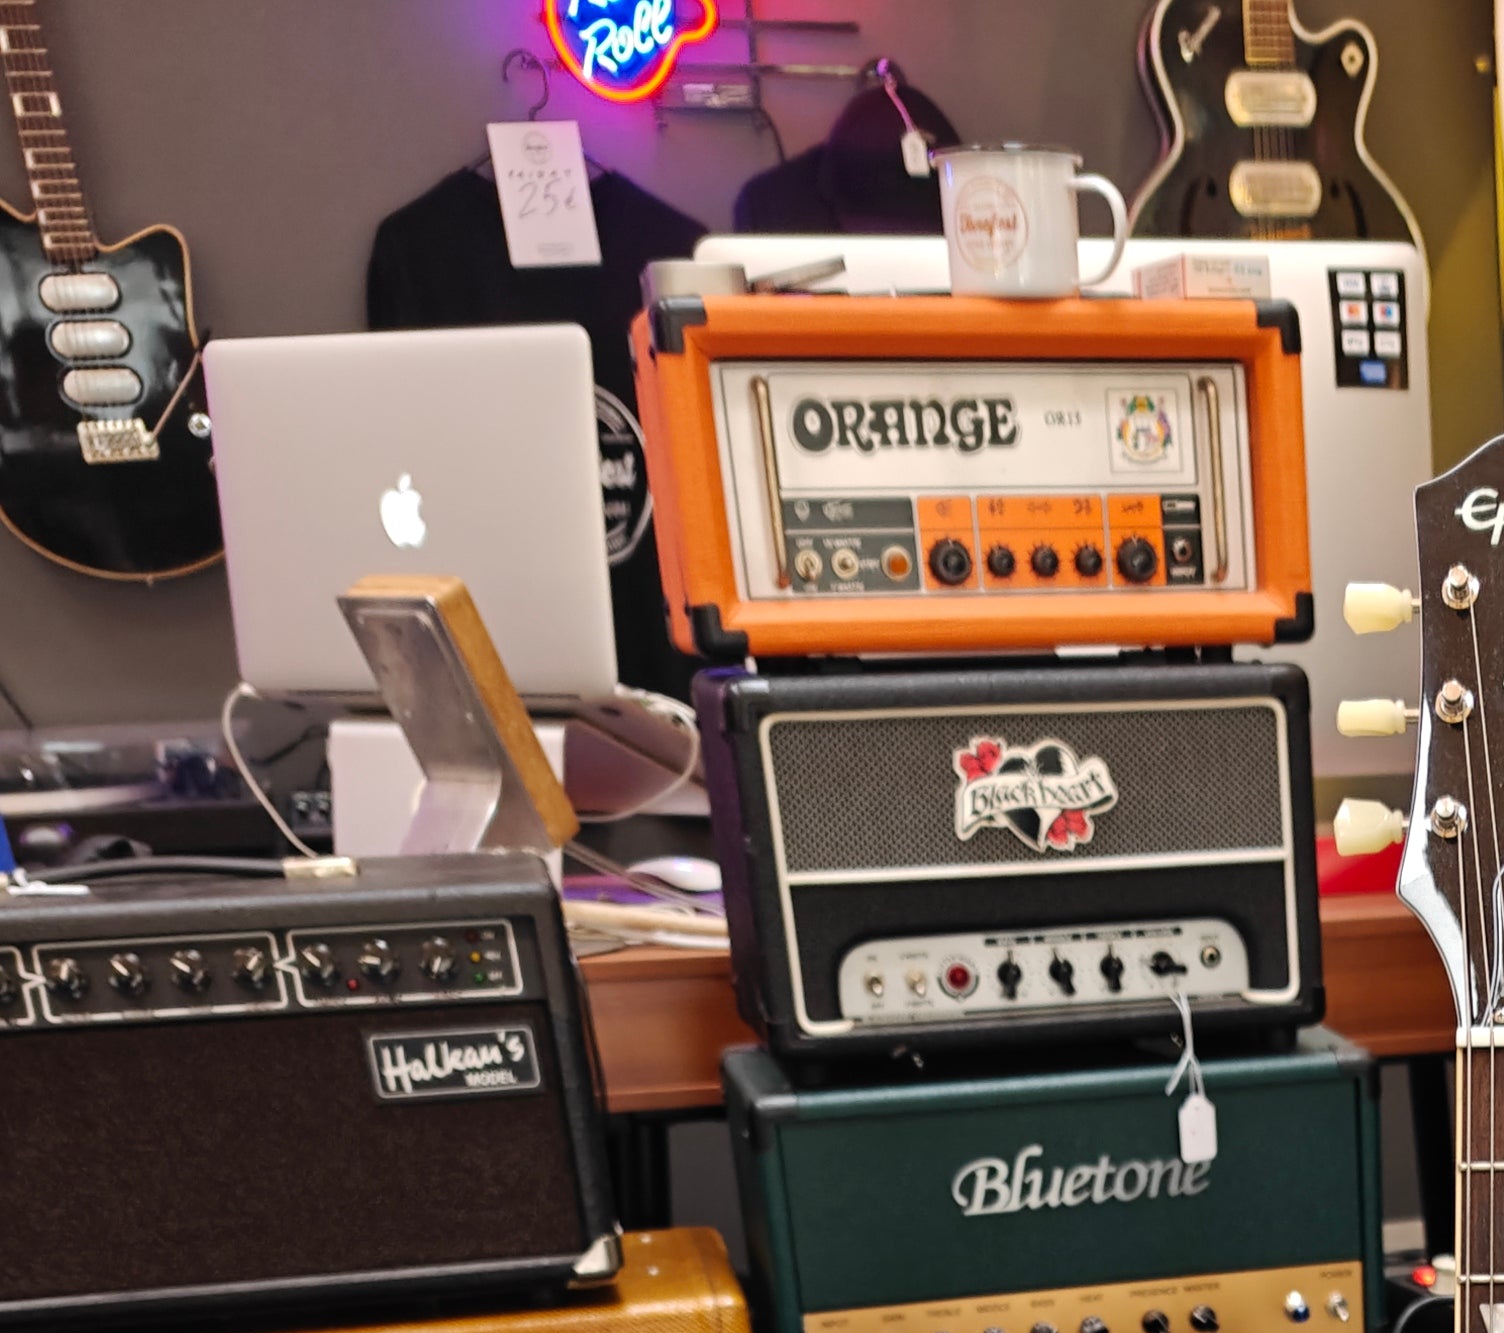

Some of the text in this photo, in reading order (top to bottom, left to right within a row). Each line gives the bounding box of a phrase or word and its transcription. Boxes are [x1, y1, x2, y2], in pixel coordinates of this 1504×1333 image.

[579, 0, 673, 79] Roll
[792, 397, 1018, 453] ORANGE
[951, 1143, 1211, 1217] Bluetone
